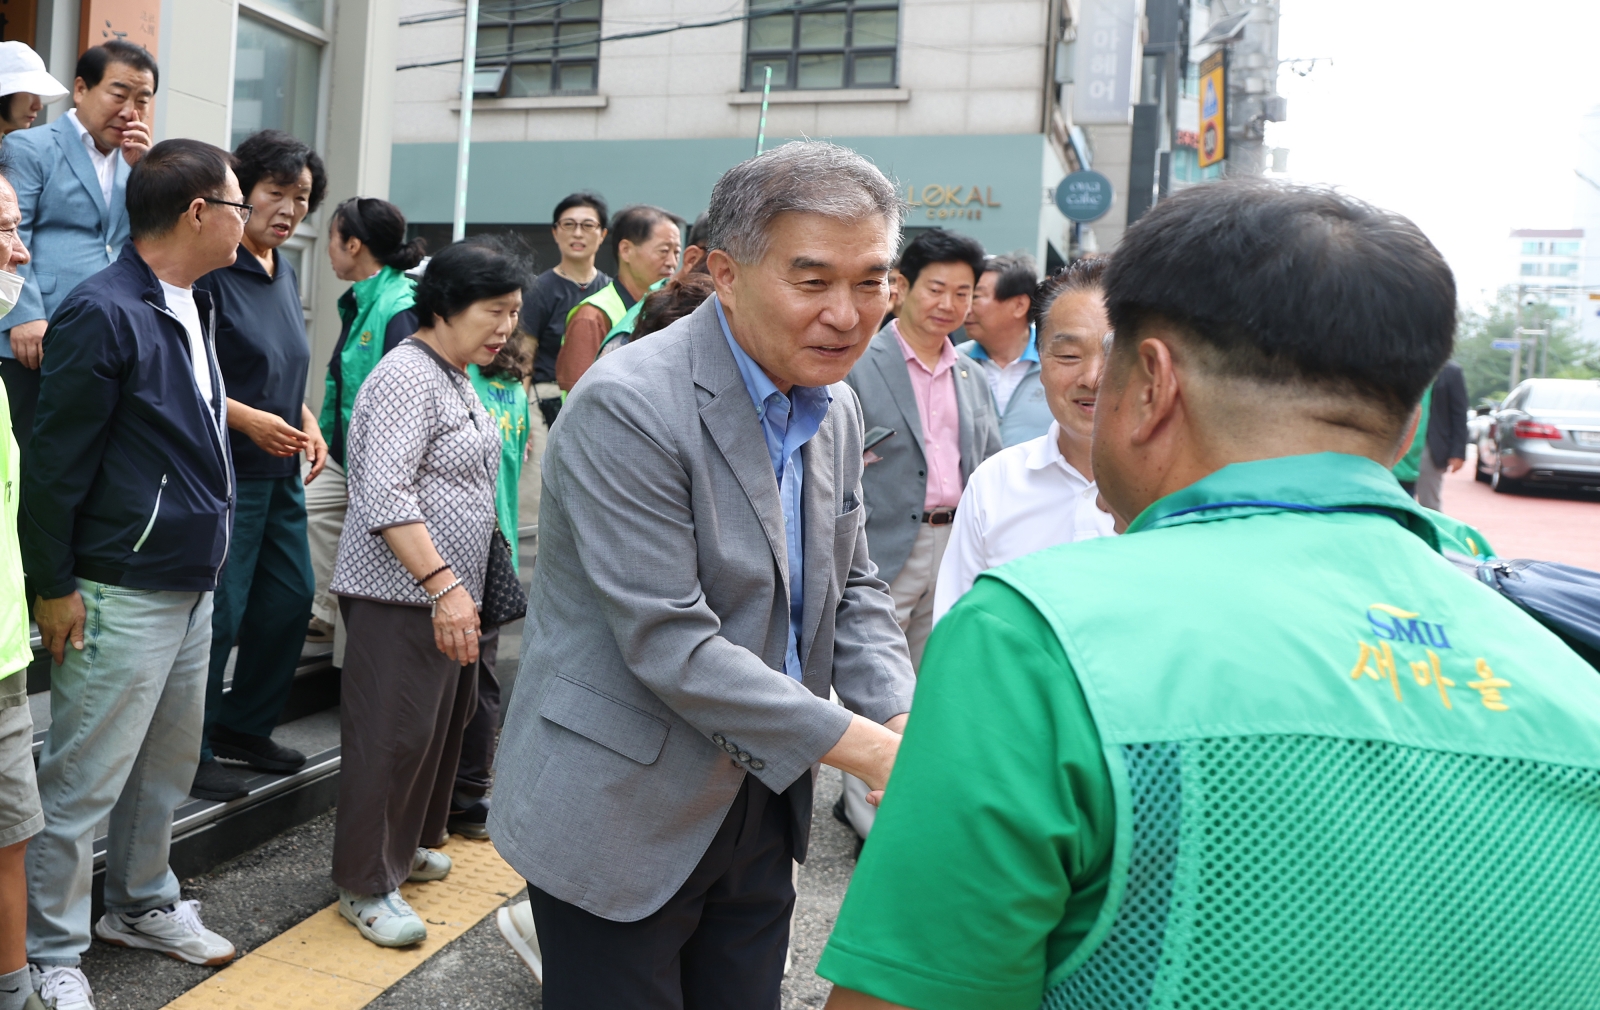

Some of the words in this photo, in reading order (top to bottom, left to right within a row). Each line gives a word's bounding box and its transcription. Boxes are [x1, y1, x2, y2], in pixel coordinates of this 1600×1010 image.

[487, 383, 515, 405] SMU
[1367, 604, 1452, 649] SMU
[1351, 640, 1511, 711] 새마을
